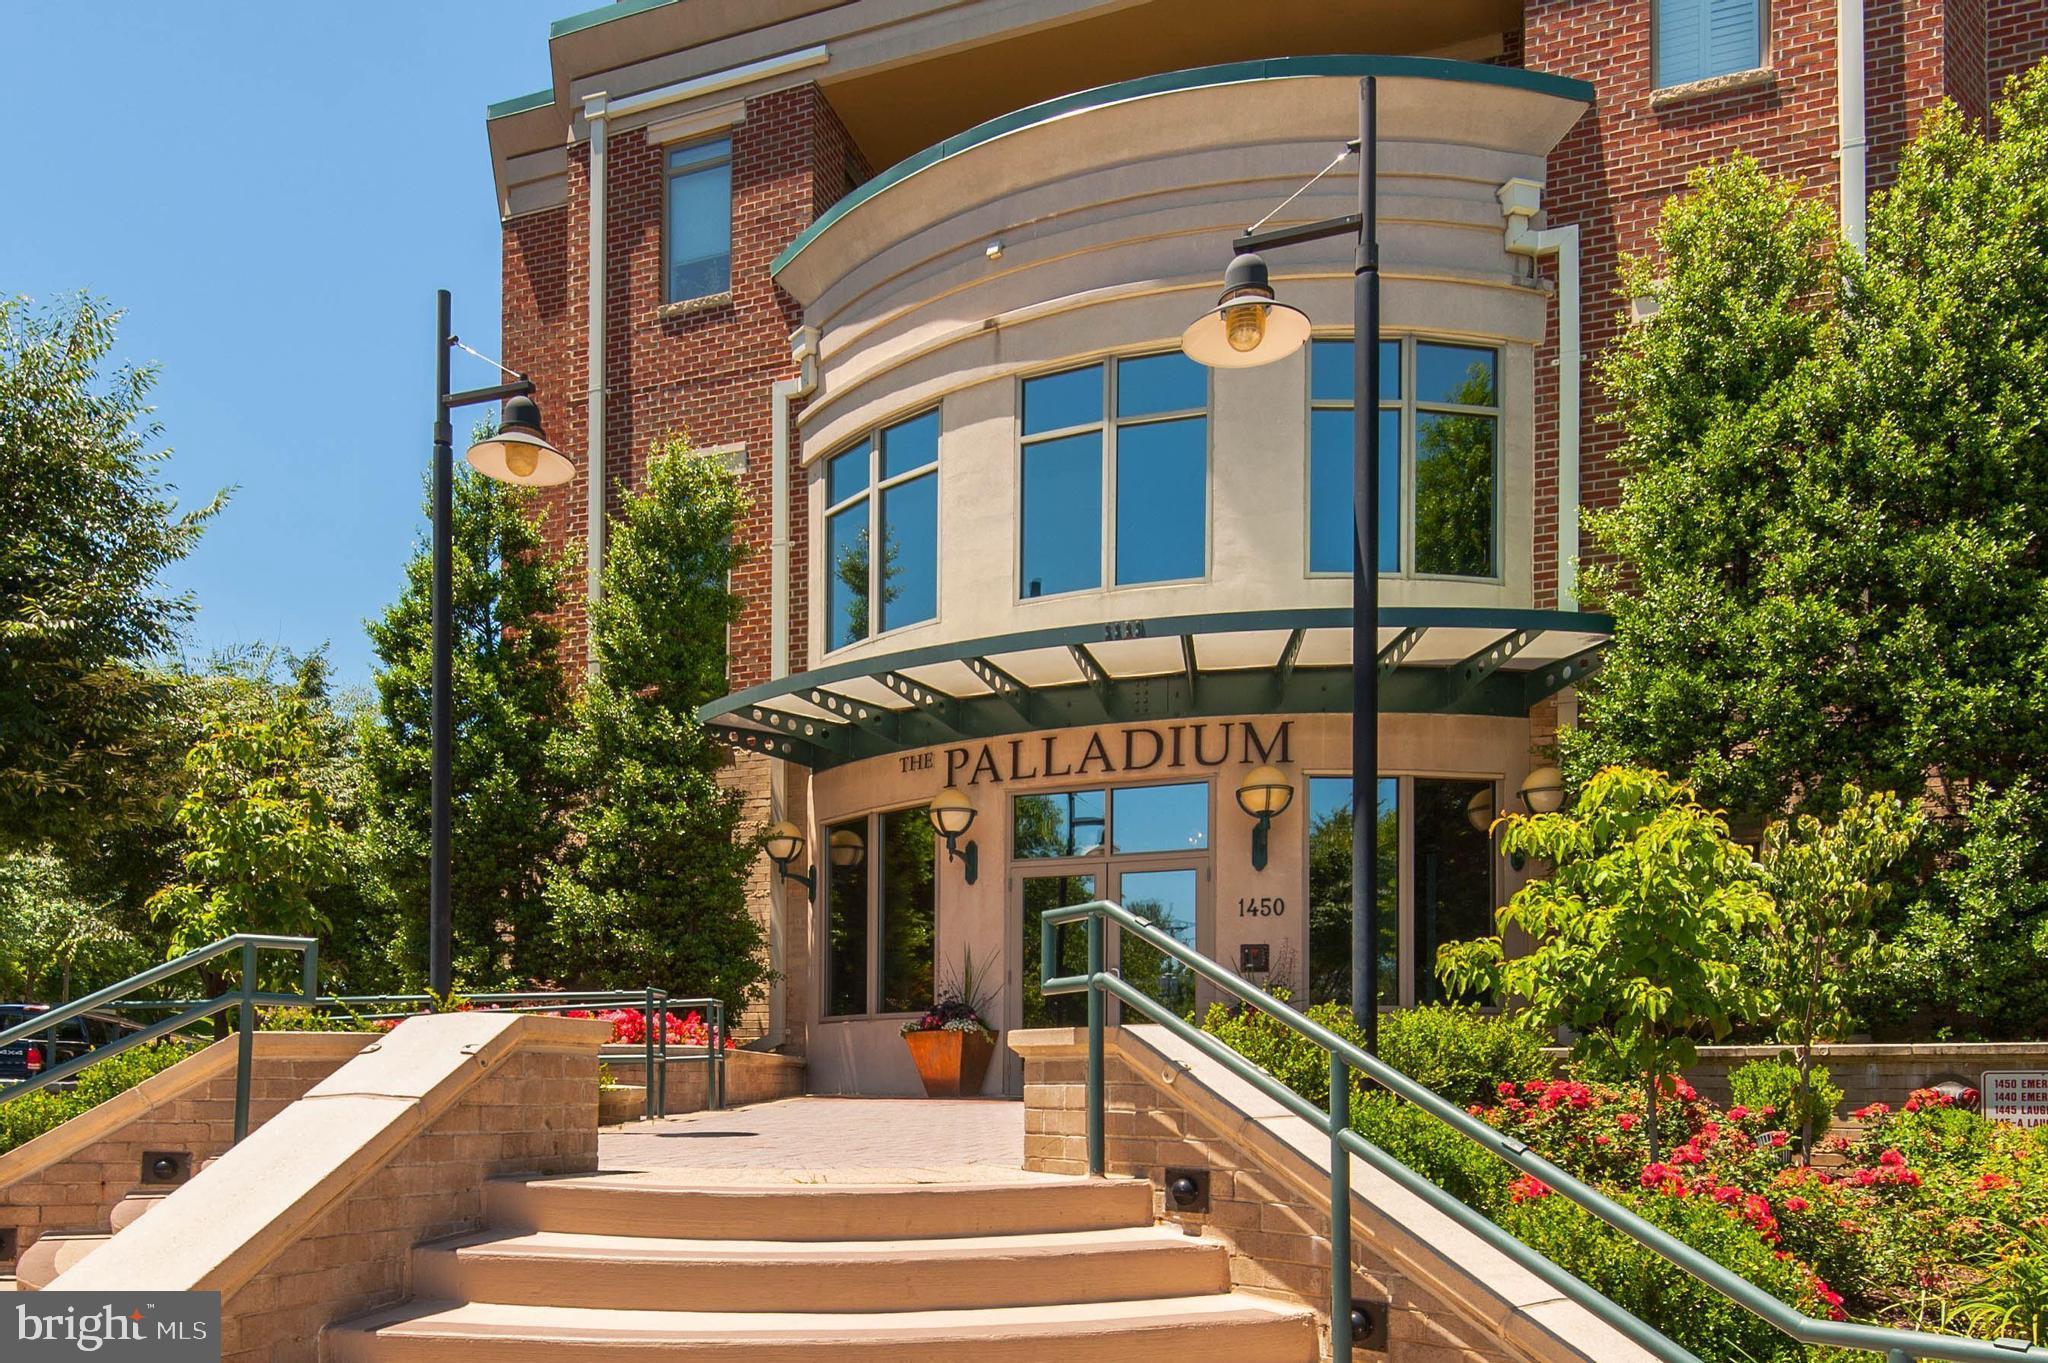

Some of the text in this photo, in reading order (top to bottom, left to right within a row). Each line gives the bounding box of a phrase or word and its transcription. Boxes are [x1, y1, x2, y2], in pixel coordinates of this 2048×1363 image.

[899, 721, 1295, 789] THE PALLADIUM
[1238, 897, 1285, 918] 1450
[1994, 1079, 2017, 1089] 1450
[1994, 1092, 2017, 1102] 1440
[1994, 1105, 2048, 1115] 1445 LAUG
